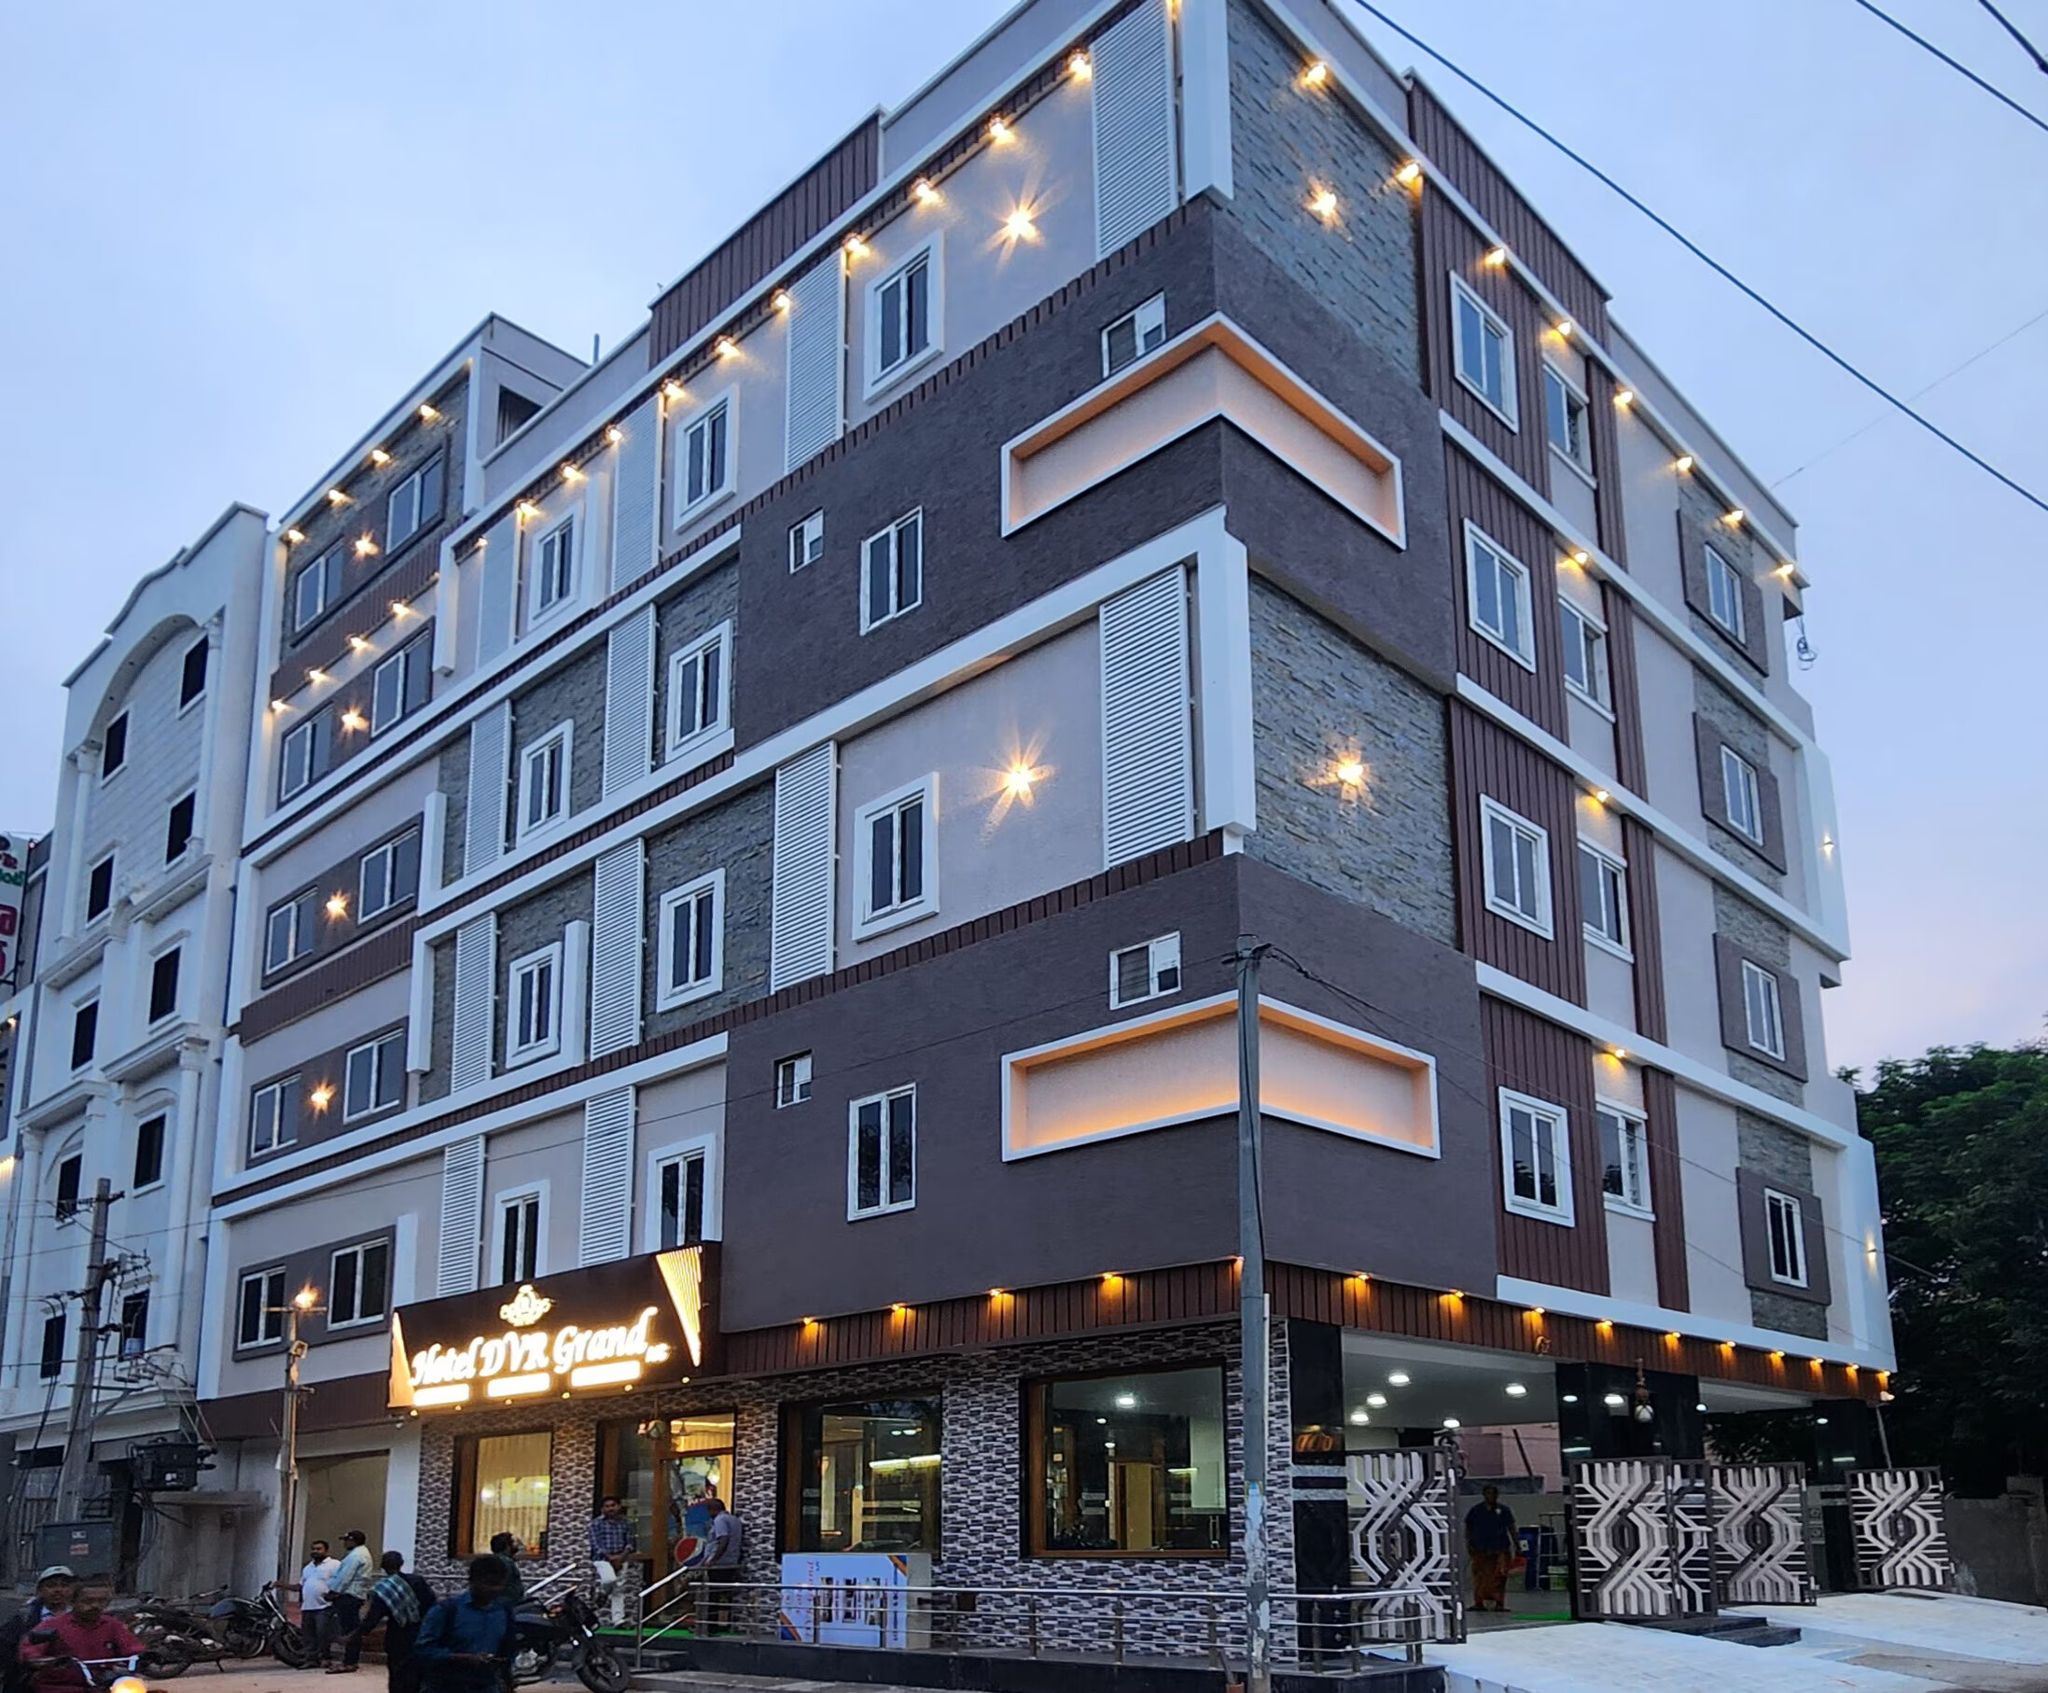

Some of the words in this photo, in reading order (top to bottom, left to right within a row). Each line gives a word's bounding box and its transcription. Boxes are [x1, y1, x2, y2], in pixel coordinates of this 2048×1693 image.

[410, 1337, 483, 1385] Hotel
[479, 1331, 549, 1377] DVR
[554, 1306, 658, 1374] Grand
